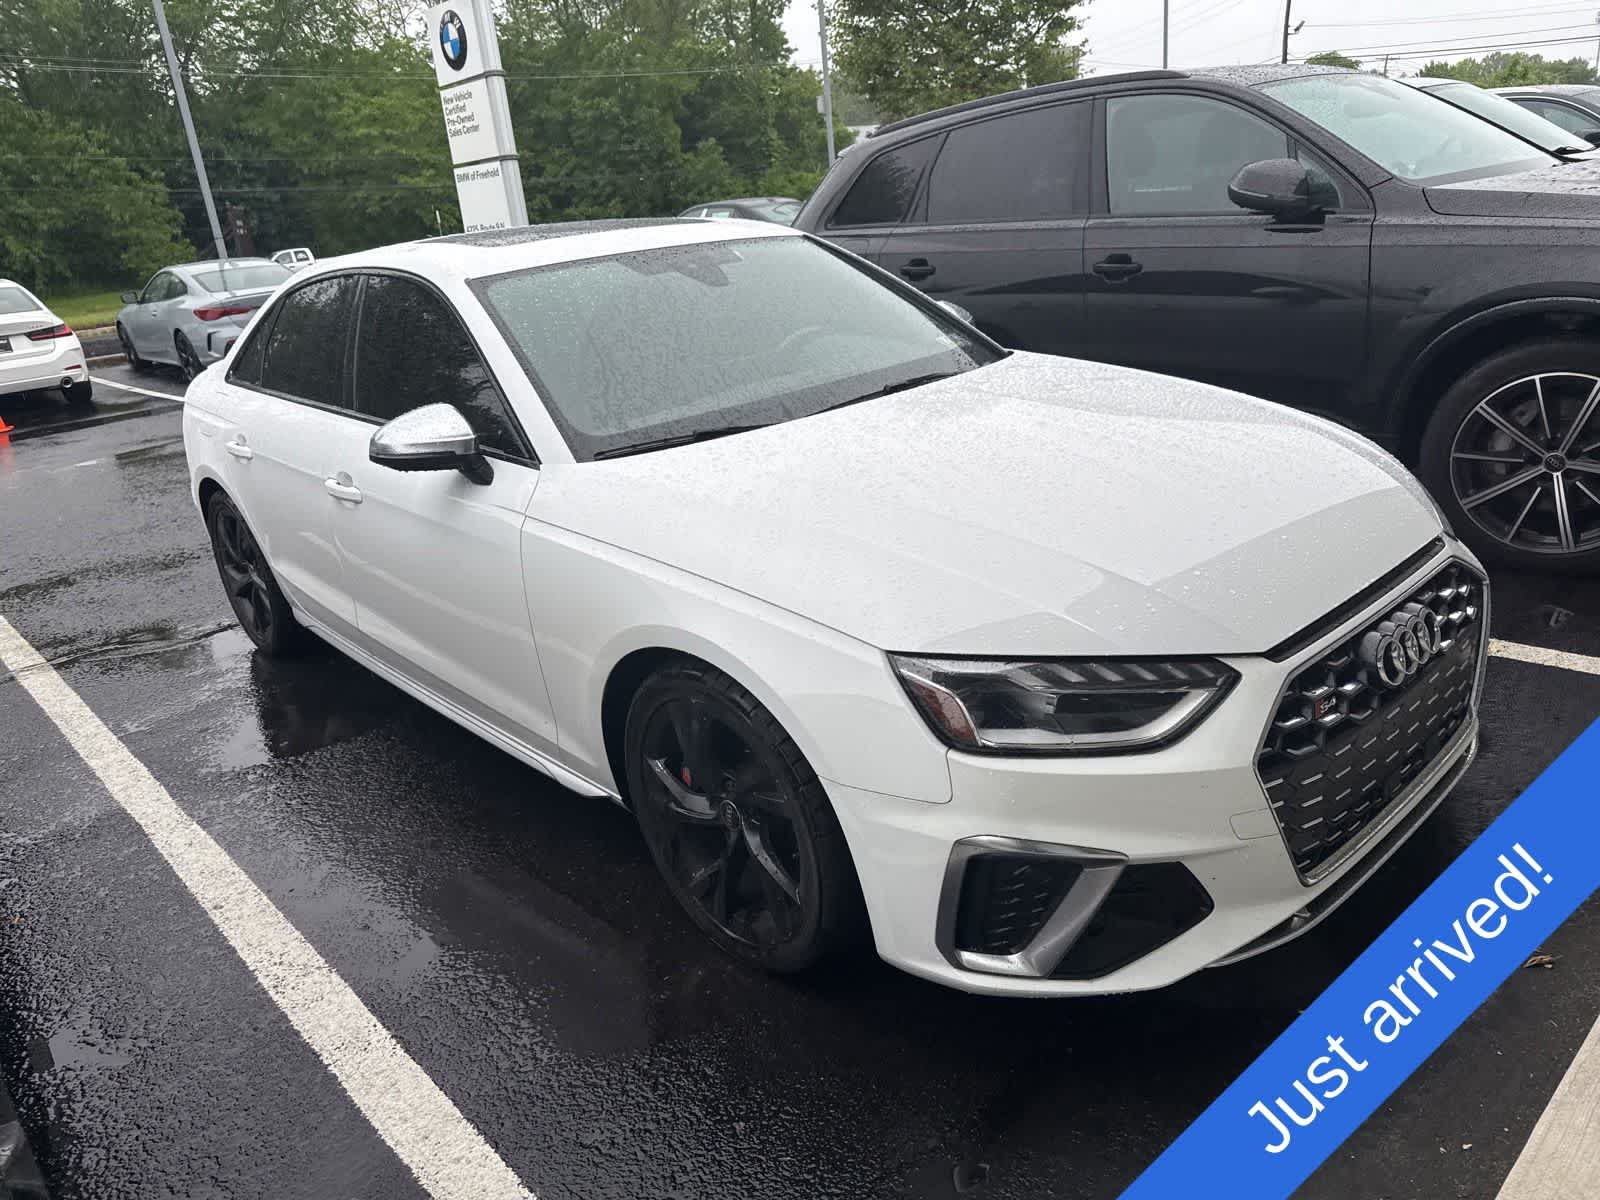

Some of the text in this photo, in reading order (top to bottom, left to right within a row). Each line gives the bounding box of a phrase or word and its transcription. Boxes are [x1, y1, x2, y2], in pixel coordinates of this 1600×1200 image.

[443, 90, 473, 105] New Vehicle
[445, 102, 467, 116] Certified
[446, 112, 475, 127] Pre-Owned
[449, 124, 480, 137] Sales Center
[456, 172, 470, 183] BMW
[476, 167, 499, 180] Freehold
